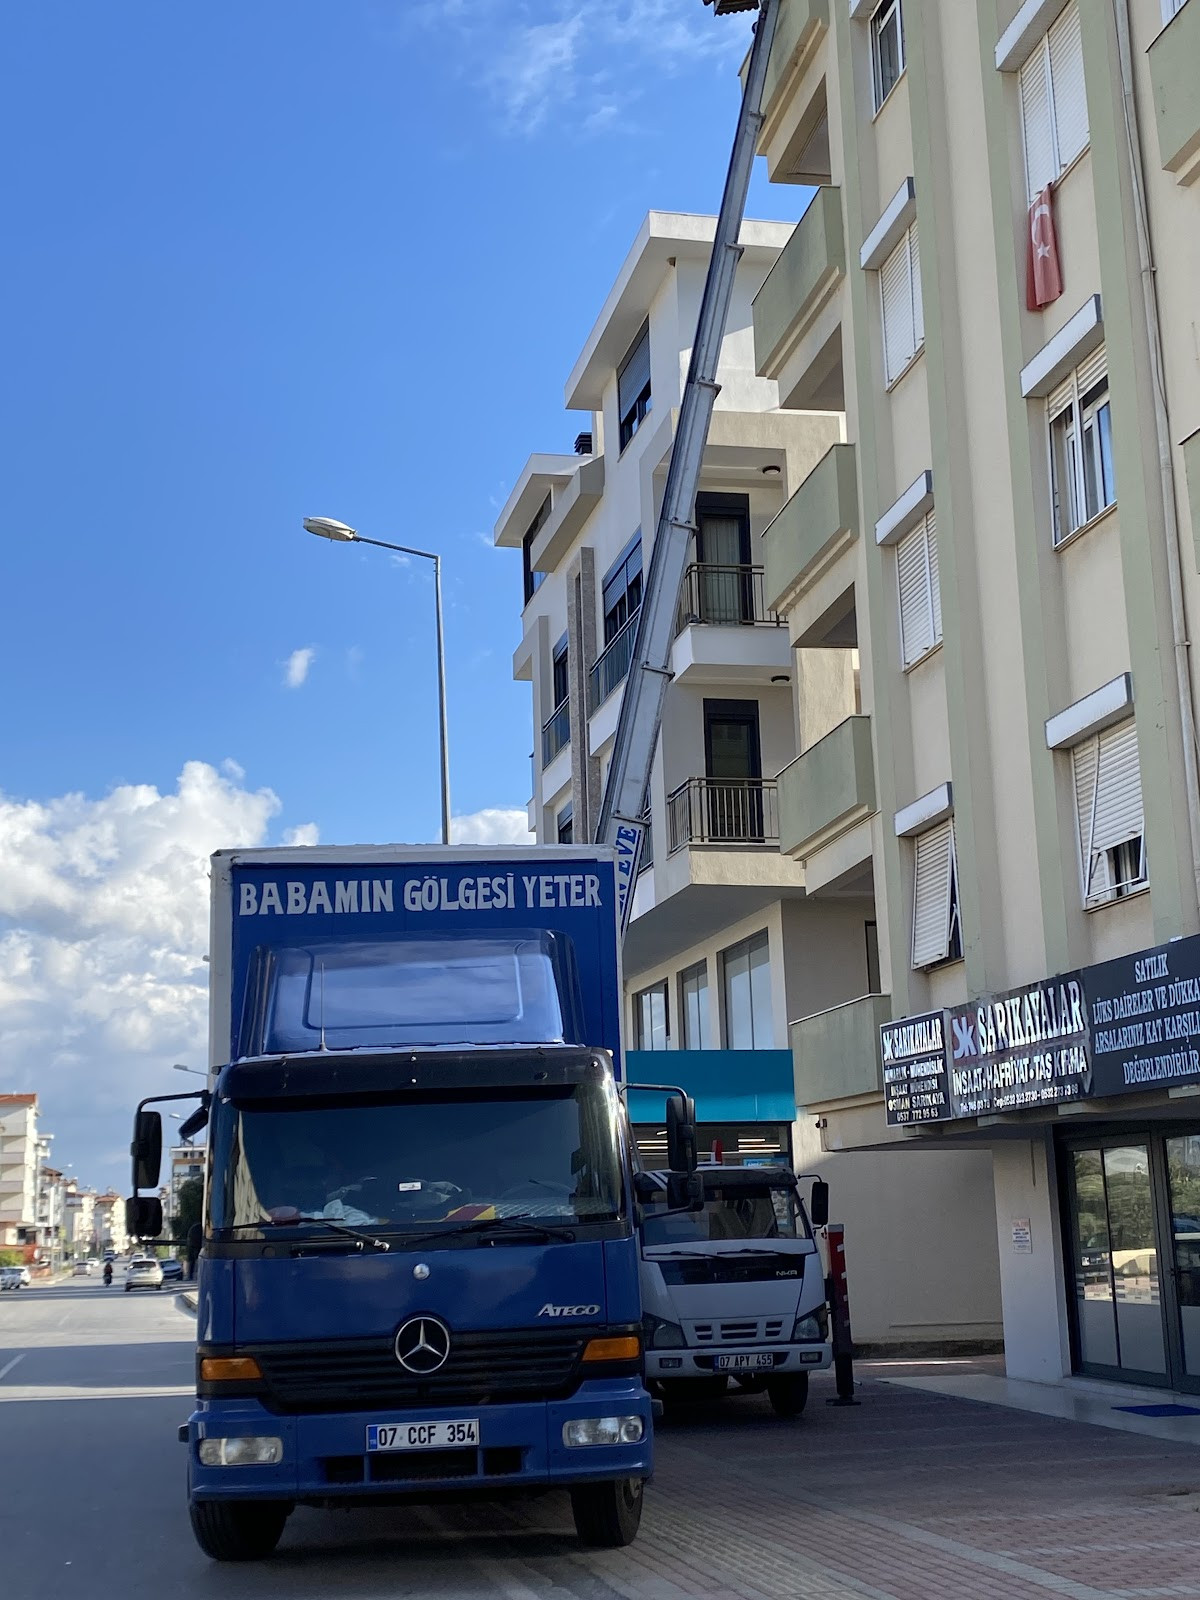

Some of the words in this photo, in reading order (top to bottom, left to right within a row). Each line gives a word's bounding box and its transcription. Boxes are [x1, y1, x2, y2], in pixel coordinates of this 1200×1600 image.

[239, 879, 394, 916] BABAMIN
[403, 872, 516, 912] GÖLGESİ
[522, 874, 603, 908] YETER
[1135, 953, 1169, 983] SATILIK
[978, 981, 1085, 1055] SARIKAYALAR
[1093, 997, 1116, 1025] LÜKS
[1113, 990, 1155, 1020] DAİRELER
[1155, 986, 1168, 1010] VE
[1168, 977, 1200, 1007] DÜKKA
[893, 1018, 943, 1058] SARIKAYALAR
[1095, 1023, 1145, 1054] ARSALARINIZ
[1145, 1019, 1163, 1044] KAT
[952, 1067, 983, 1098] İNŞAAT
[986, 1057, 1030, 1089] HAFRİYAT
[1034, 1053, 1053, 1082] TAŞ
[911, 1091, 946, 1108] SARIKAYA
[911, 1109, 923, 1120] 772
[720, 1355, 731, 1368] 07
[734, 1354, 751, 1367] APY
[756, 1353, 772, 1366] 455
[378, 1427, 398, 1446] 07
[407, 1424, 437, 1445] CCF
[446, 1422, 476, 1443] 354
